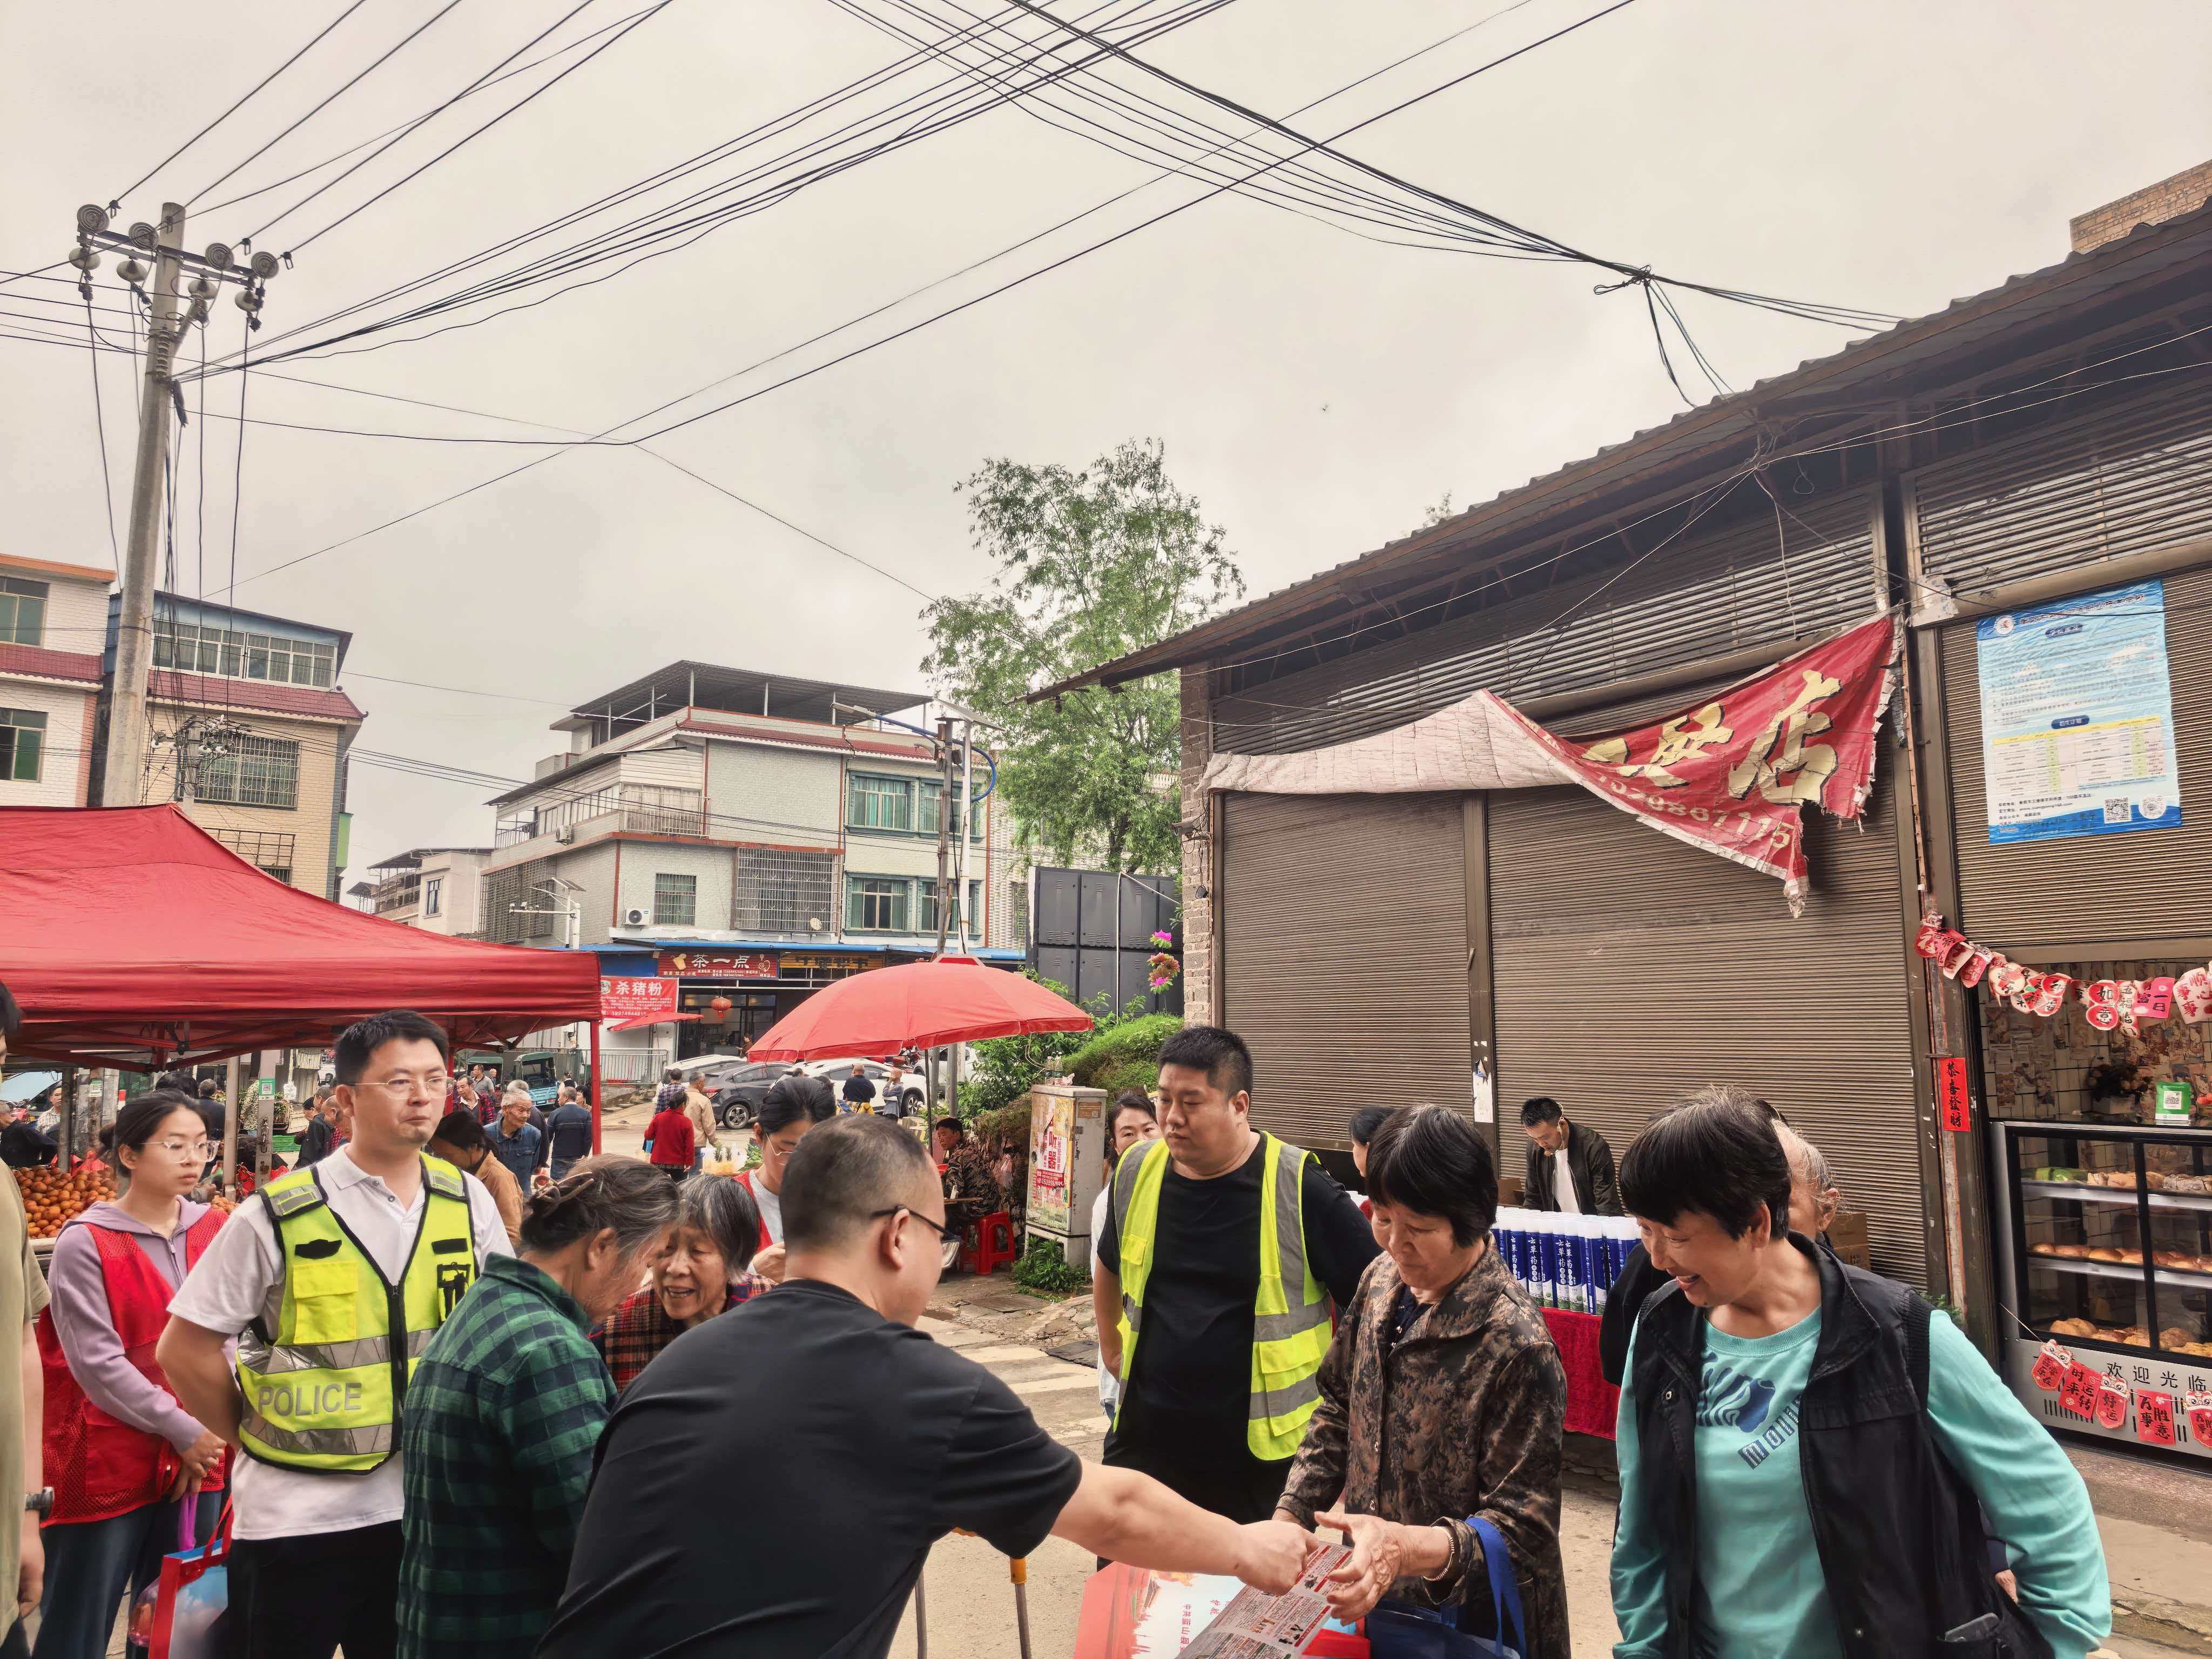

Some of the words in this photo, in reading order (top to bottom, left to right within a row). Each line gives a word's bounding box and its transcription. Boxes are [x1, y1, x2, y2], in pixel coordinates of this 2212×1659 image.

[691, 953, 750, 969] 茶一点
[616, 981, 663, 996] 杀猪粉
[2106, 1361, 2206, 1392] 欢迎光临
[258, 1382, 362, 1417] POLICE
[2103, 1392, 2118, 1421] 好运
